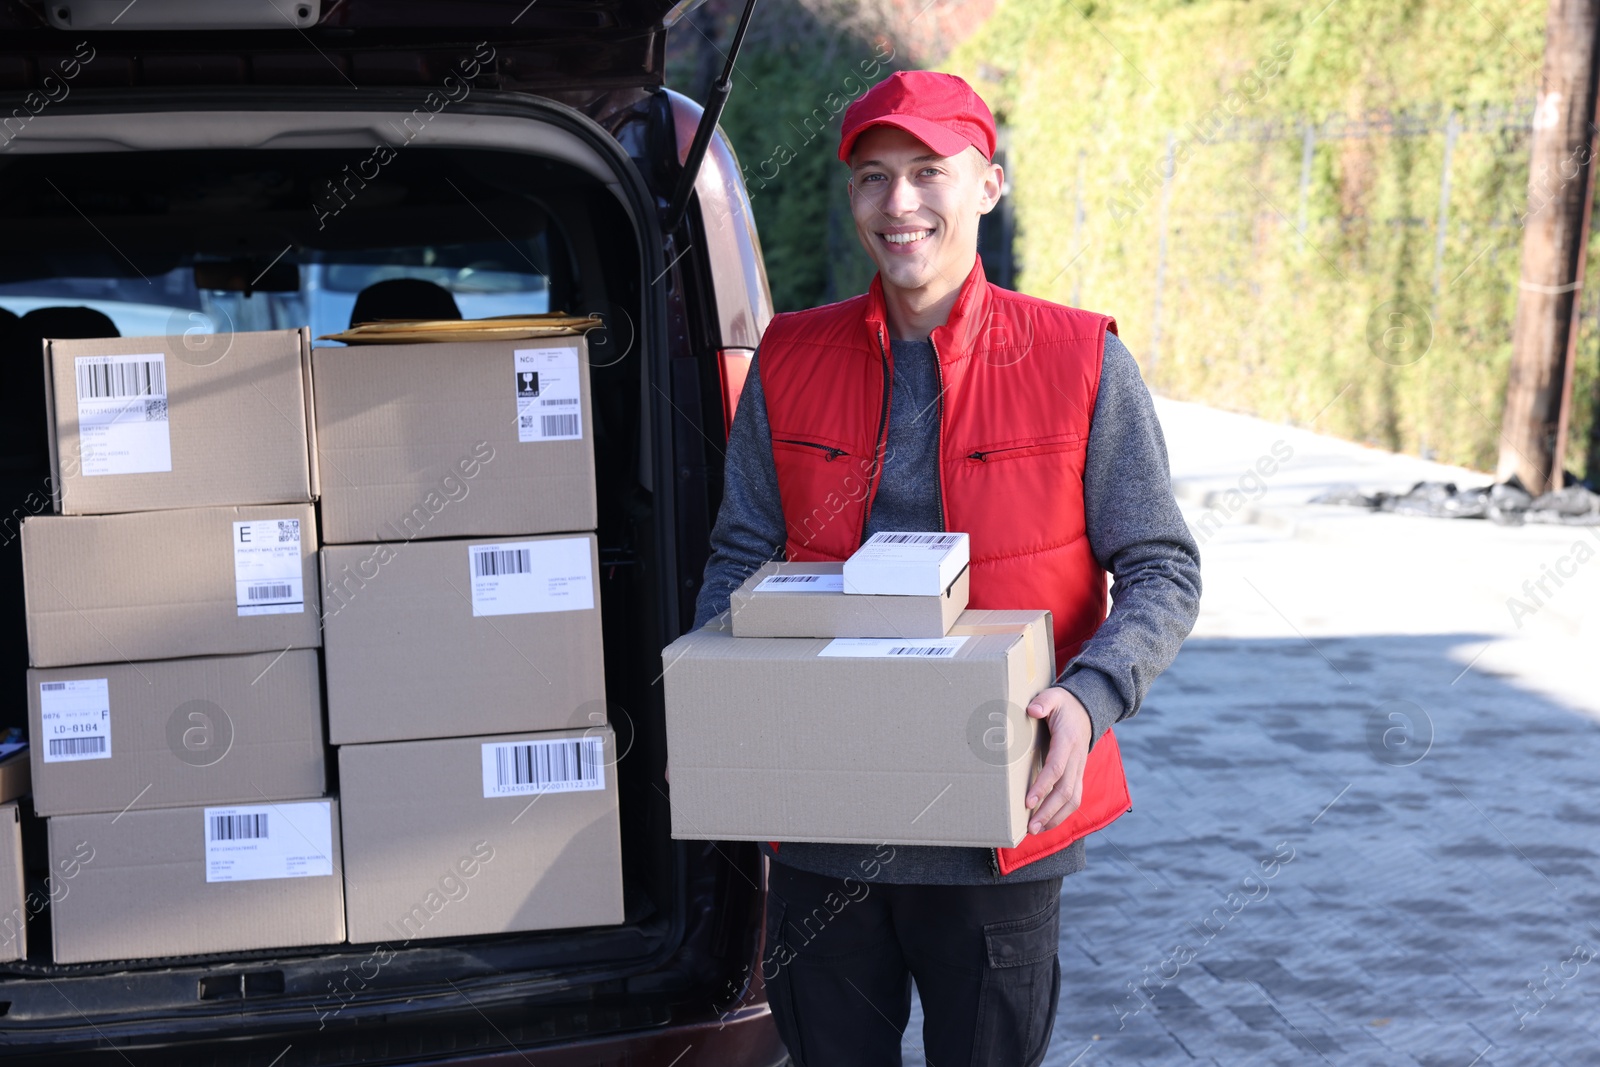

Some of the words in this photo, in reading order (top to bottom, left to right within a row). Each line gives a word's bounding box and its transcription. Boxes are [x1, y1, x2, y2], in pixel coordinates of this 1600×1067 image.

[240, 526, 251, 543] E
[101, 710, 108, 720] F
[501, 785, 535, 793] 2345678
